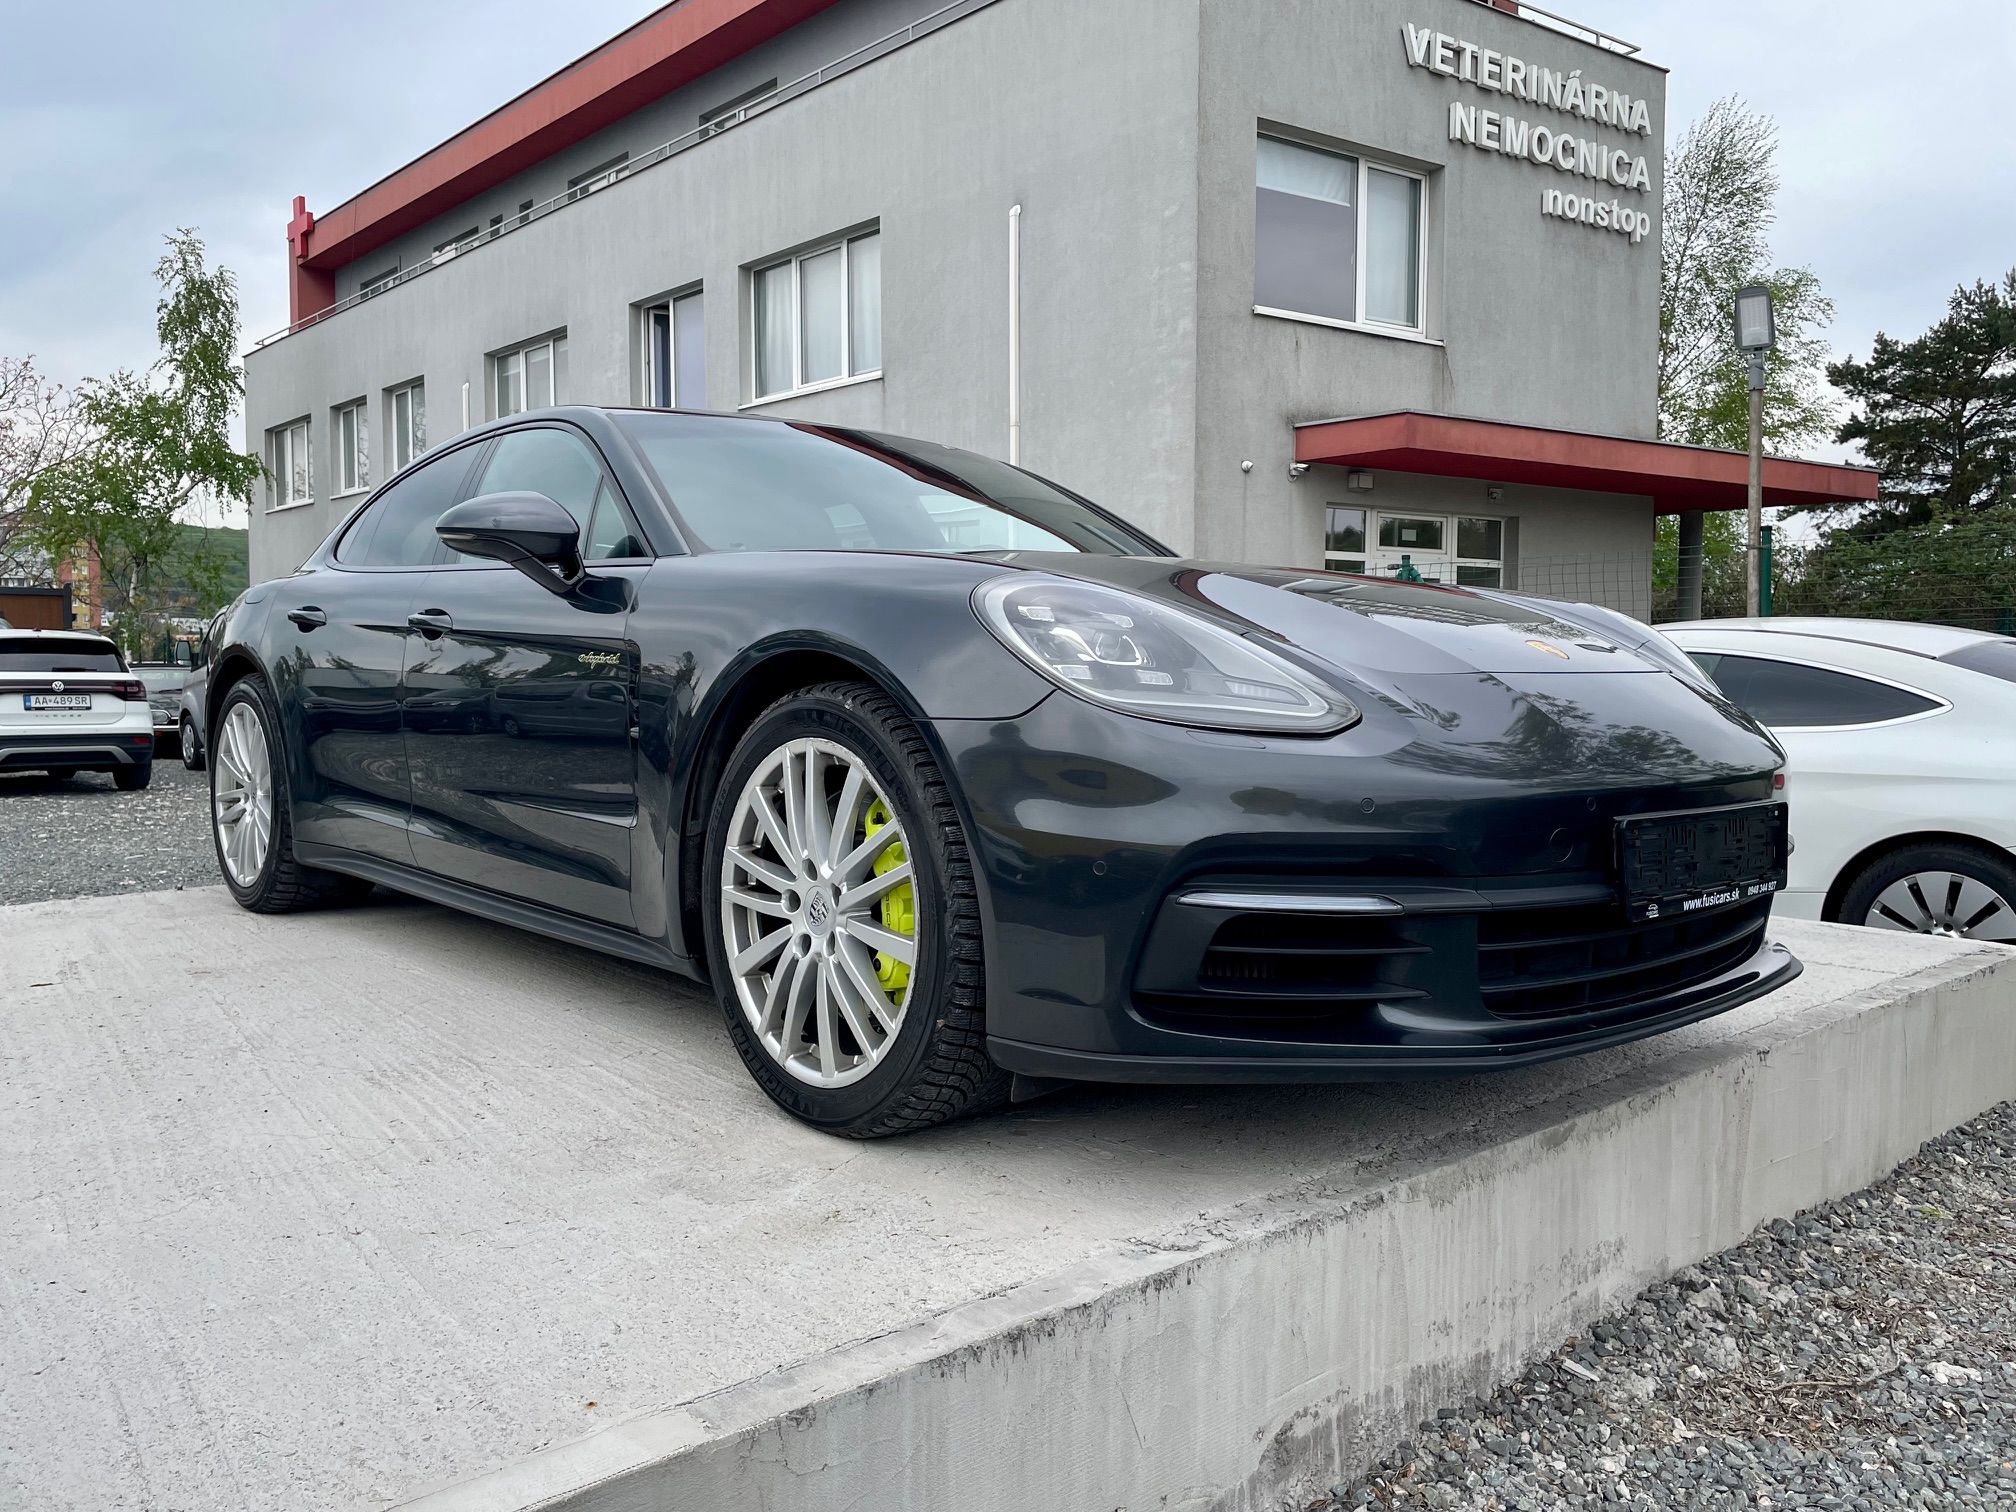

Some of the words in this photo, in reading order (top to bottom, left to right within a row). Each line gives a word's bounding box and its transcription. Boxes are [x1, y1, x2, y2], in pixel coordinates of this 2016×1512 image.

[1402, 22, 1651, 137] VETERINÁRNA
[1449, 101, 1651, 192] NEMOCNICA
[1542, 188, 1651, 243] nonstop
[1683, 887, 1740, 911] www.fusicars.sk
[732, 1022, 798, 1105] MICHELIN
